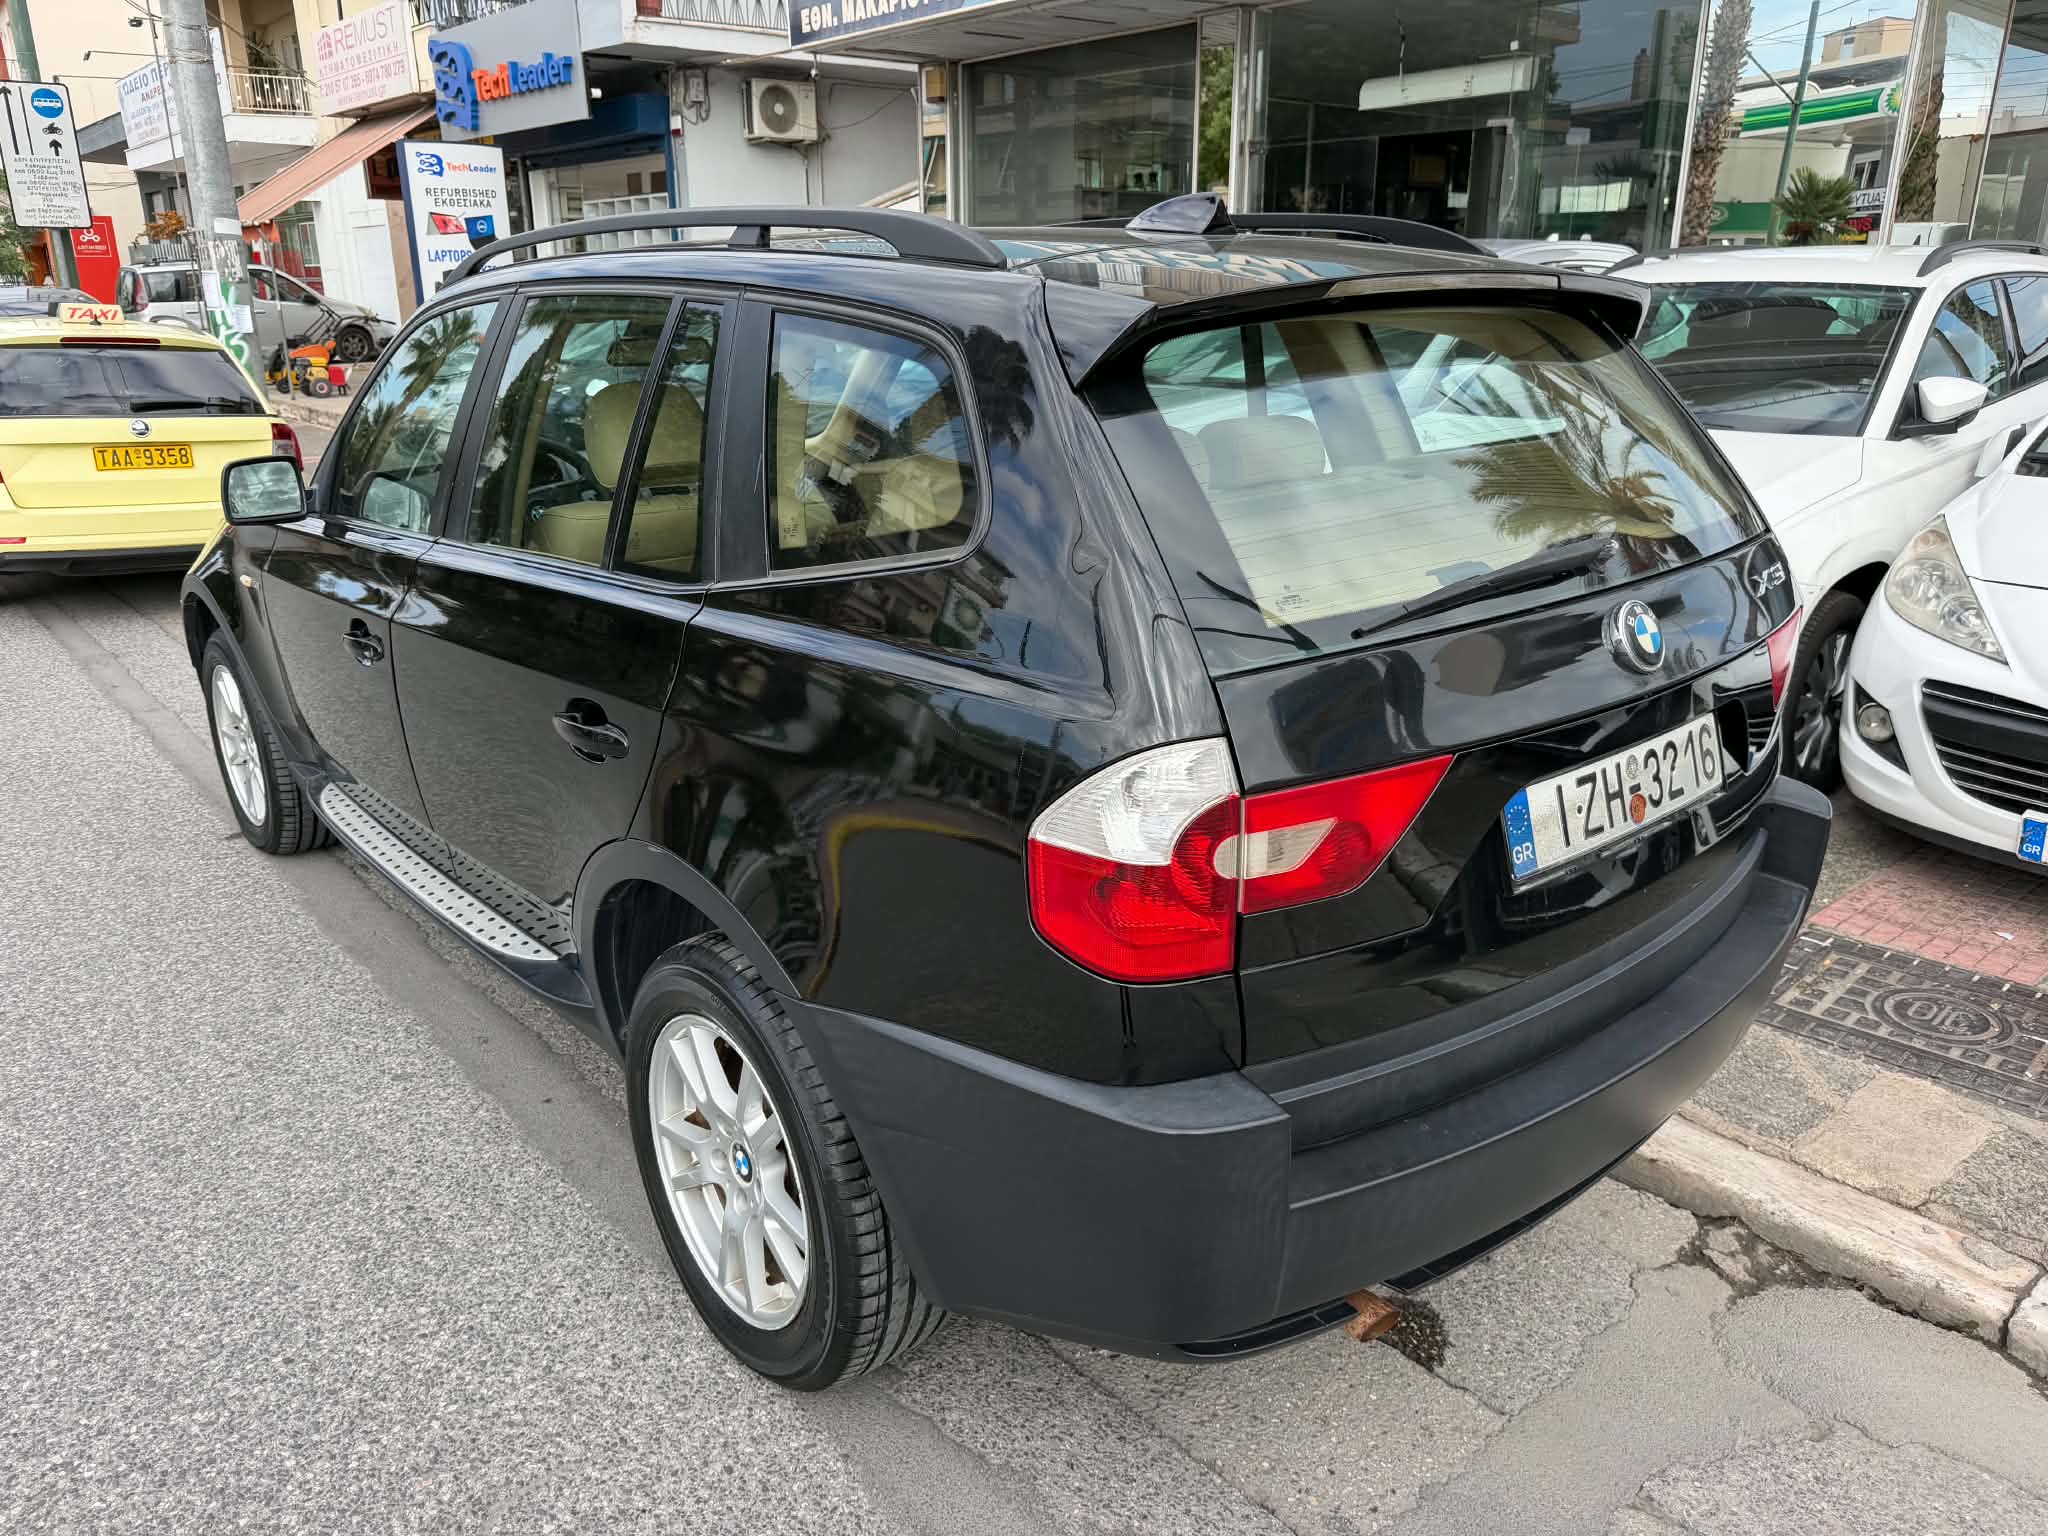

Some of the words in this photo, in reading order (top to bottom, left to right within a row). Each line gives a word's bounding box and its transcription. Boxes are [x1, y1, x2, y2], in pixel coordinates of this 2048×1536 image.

[334, 6, 395, 53] REMUST
[471, 52, 573, 102] TechLeader
[446, 162, 497, 173] TechLeader
[425, 187, 497, 199] REFURBISHED
[434, 197, 492, 208] ΕΚΘΕΣΙΑΚΑ
[67, 307, 119, 320] TAXI
[1751, 561, 1786, 598] X3
[1512, 842, 1534, 864] GR
[2023, 843, 2040, 856] GR
